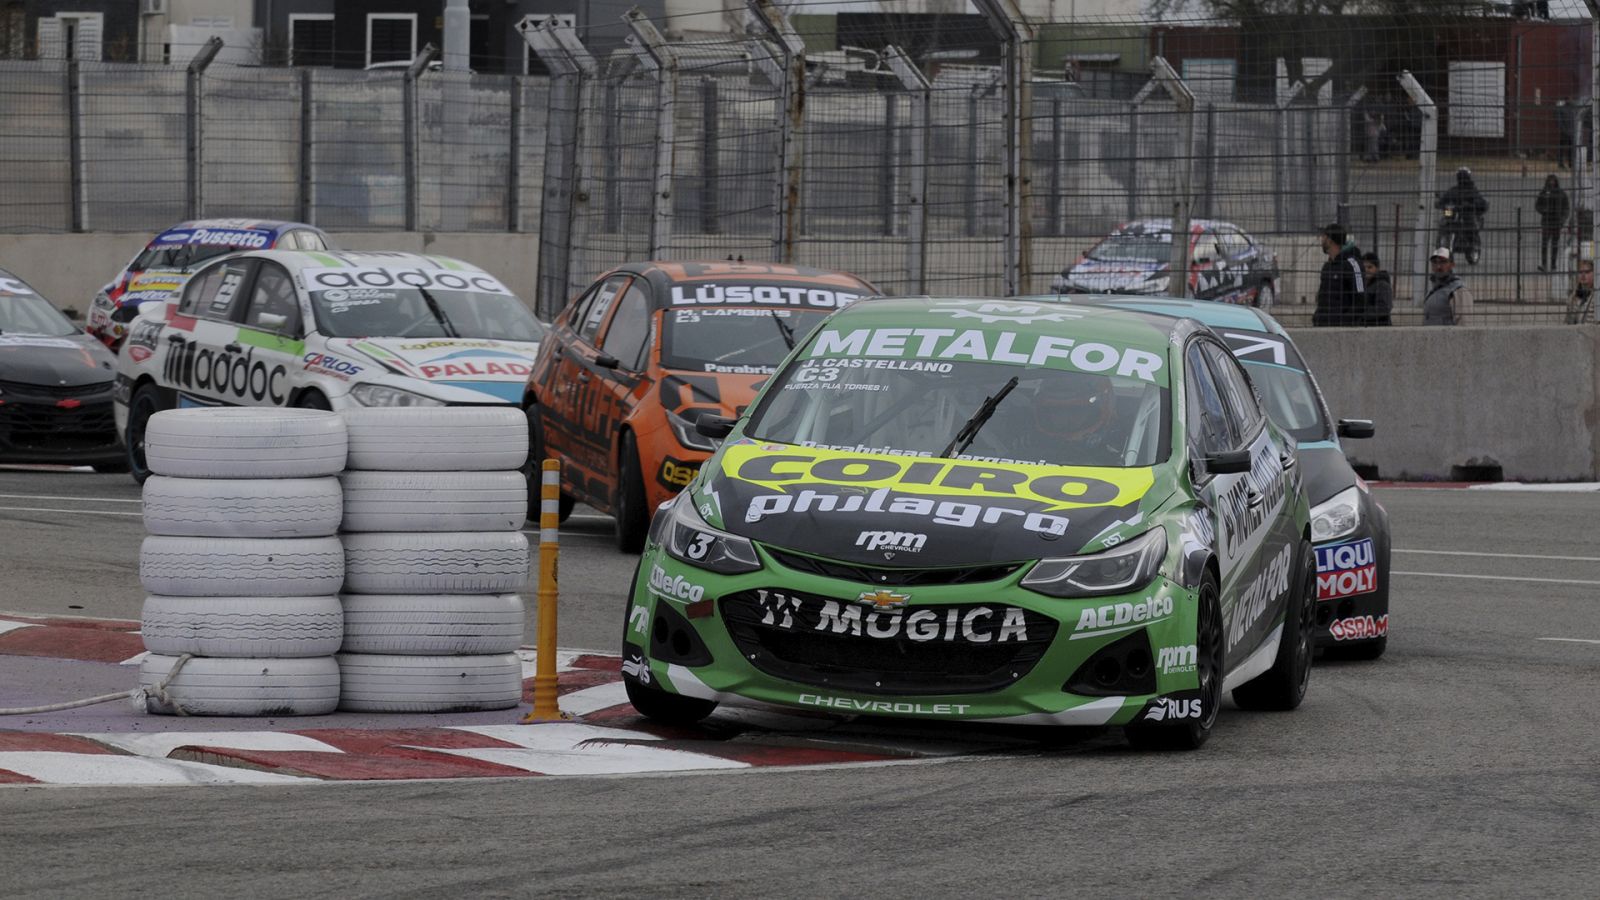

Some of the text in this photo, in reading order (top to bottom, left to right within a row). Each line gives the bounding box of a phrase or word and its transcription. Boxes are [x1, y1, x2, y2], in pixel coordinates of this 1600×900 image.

[188, 228, 267, 248] Pussetto
[315, 267, 502, 292] addoc
[671, 284, 866, 308] LÜSQTOF
[303, 352, 365, 375] CARLOS
[811, 328, 1163, 383] METALFOR
[784, 383, 819, 391] FUERZA
[844, 383, 880, 391] TORRES
[796, 368, 840, 382] C3
[738, 455, 1120, 504] COIRO
[745, 488, 1070, 536] philagro
[687, 532, 715, 560] 3
[855, 531, 928, 551] rpm
[1314, 541, 1374, 572] LIQUI
[1316, 566, 1376, 598] MOLY
[1074, 596, 1174, 631] ACDelco
[1329, 614, 1389, 640] OSRAM
[1156, 645, 1198, 675] rpm
[798, 693, 971, 715] CHEVROLET
[1168, 699, 1202, 719] RUS
